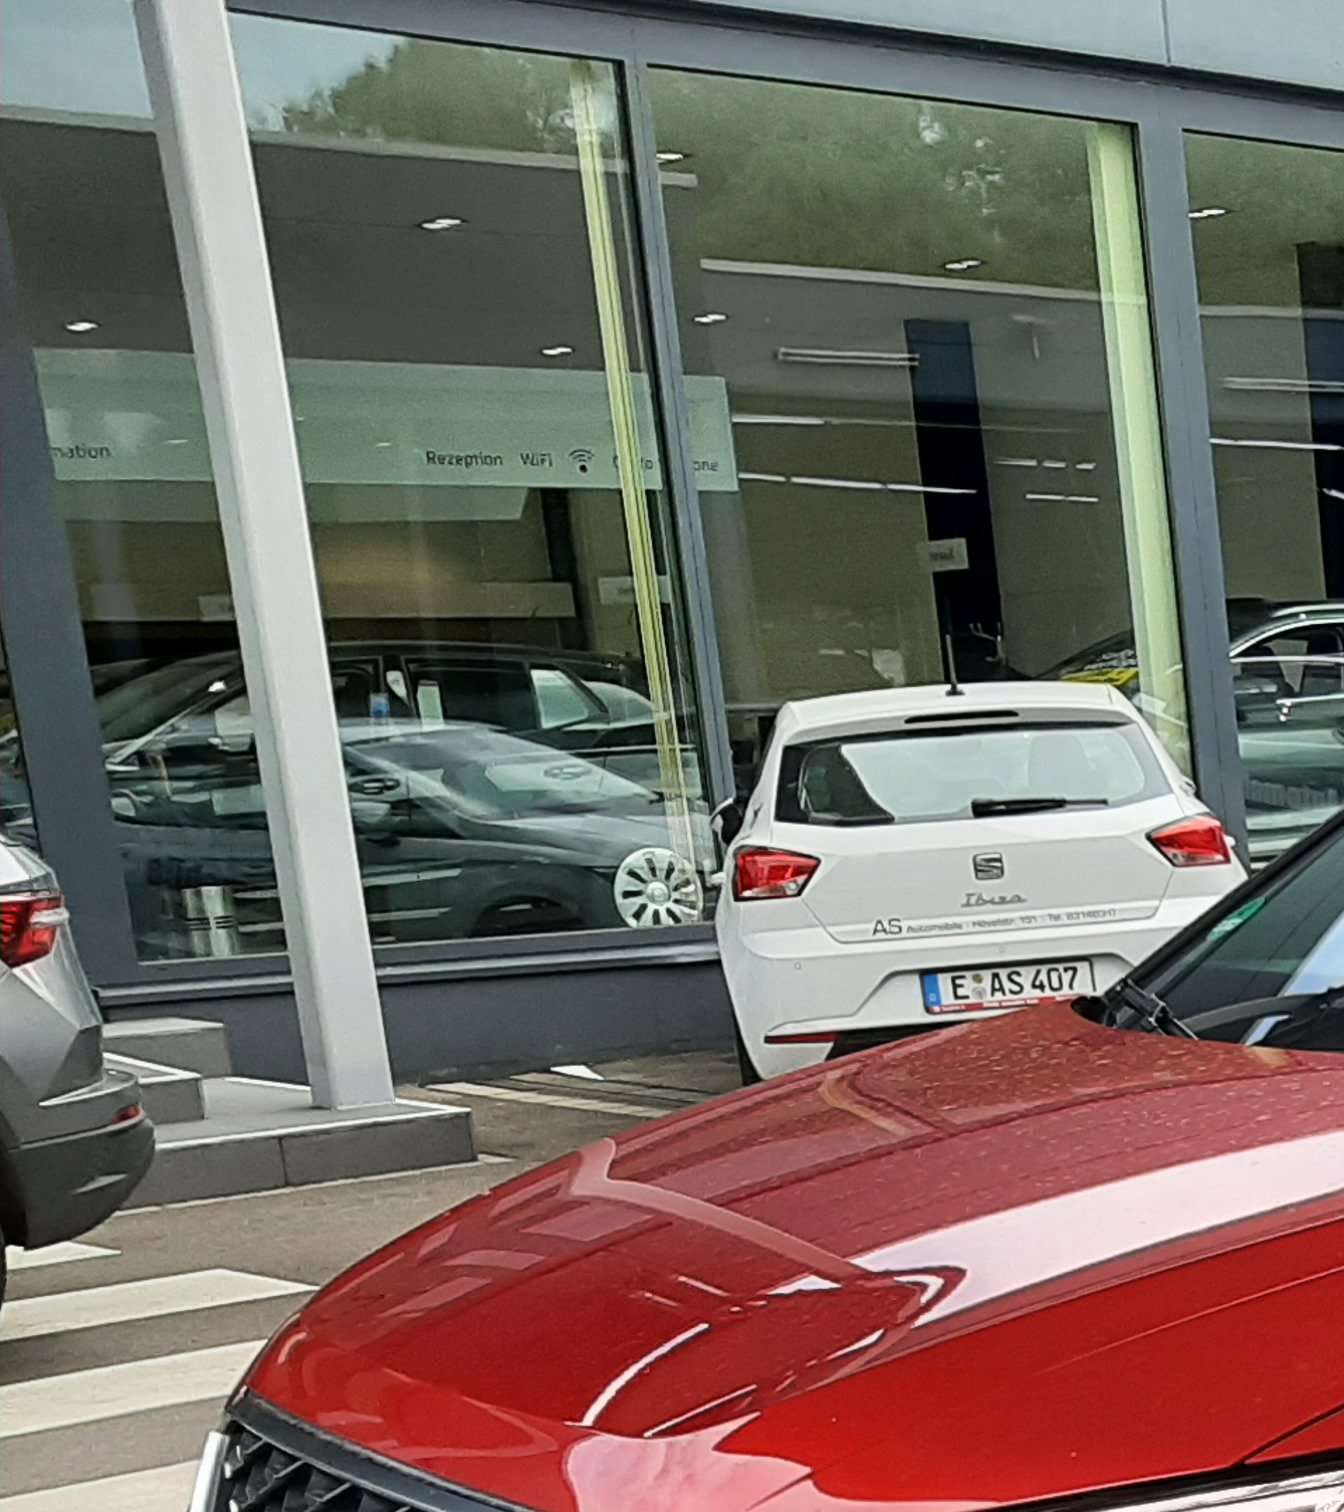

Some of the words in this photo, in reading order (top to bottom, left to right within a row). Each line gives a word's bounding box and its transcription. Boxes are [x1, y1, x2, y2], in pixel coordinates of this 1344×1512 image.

[426, 450, 503, 468] Rezeption
[520, 452, 553, 467] WiFi
[961, 893, 1028, 908] Ibiza
[872, 918, 902, 936] AS
[951, 975, 970, 1000] E
